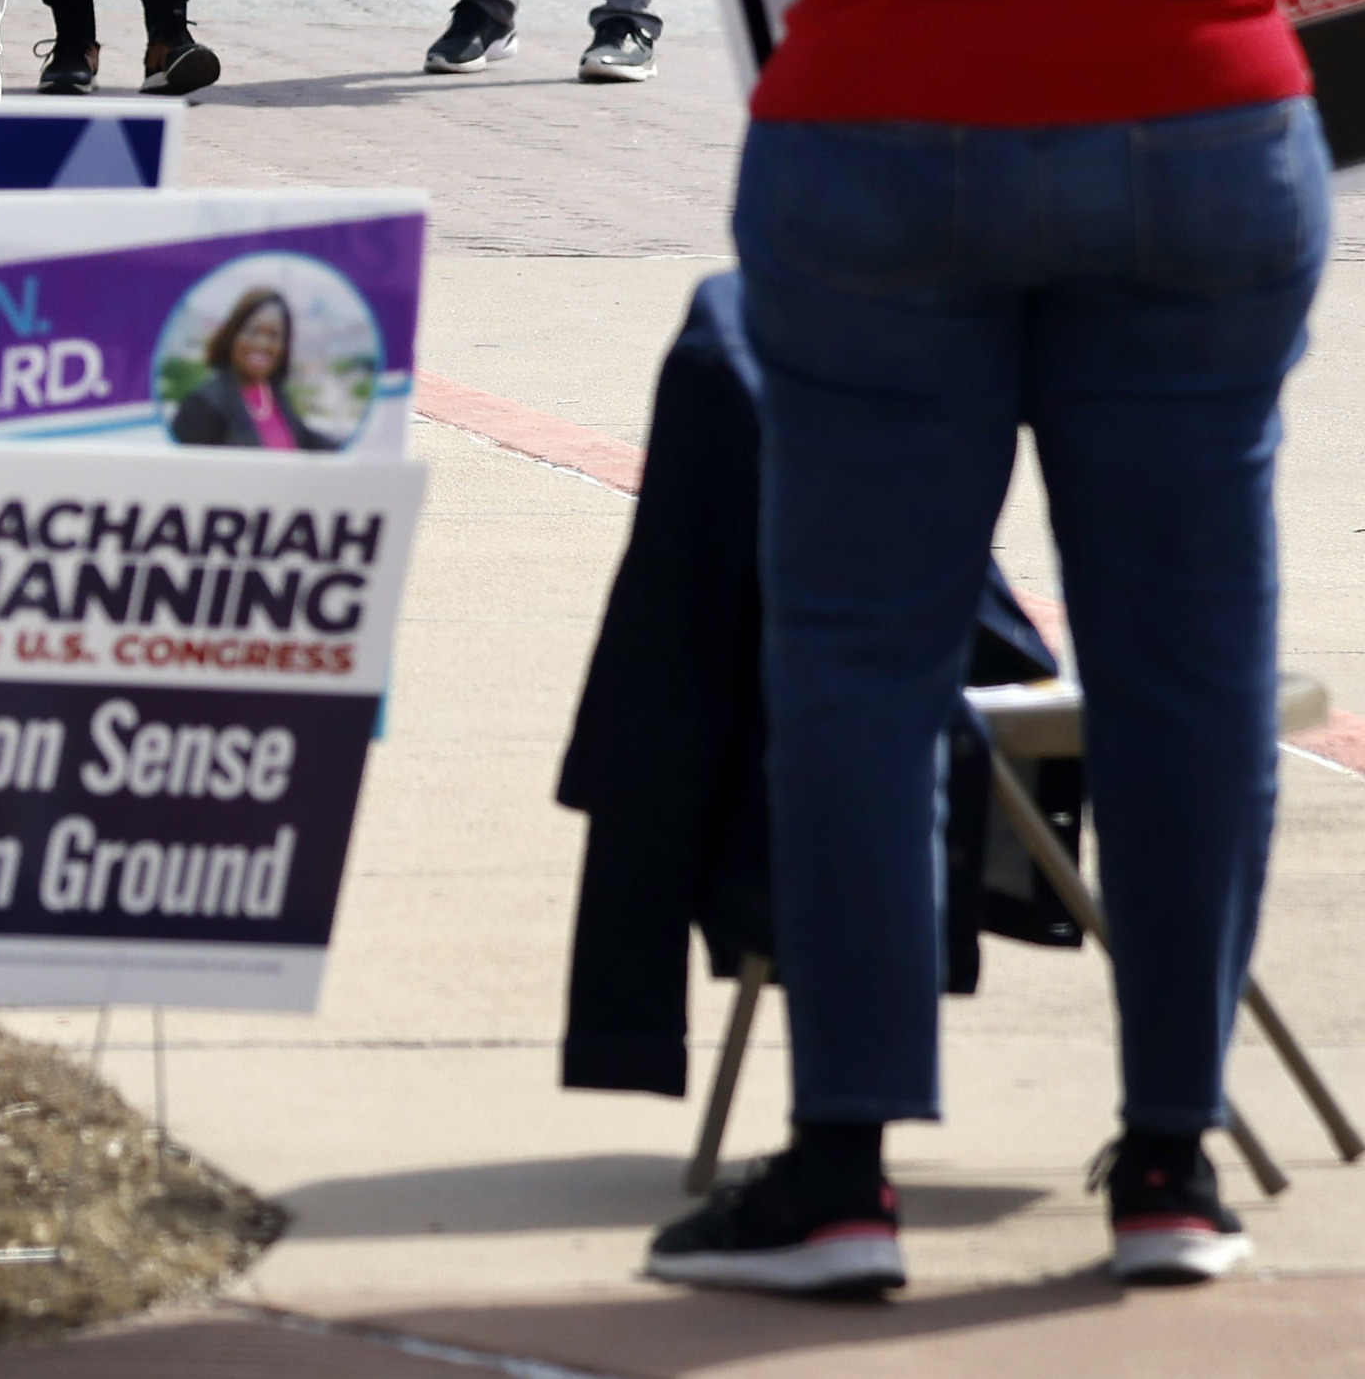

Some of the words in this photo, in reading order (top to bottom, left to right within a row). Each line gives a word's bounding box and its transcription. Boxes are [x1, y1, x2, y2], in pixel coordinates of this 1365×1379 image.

[17, 631, 95, 666] U.S.
[113, 633, 356, 675] CONGRESS
[80, 697, 297, 803] Sense
[38, 816, 297, 920] Ground
